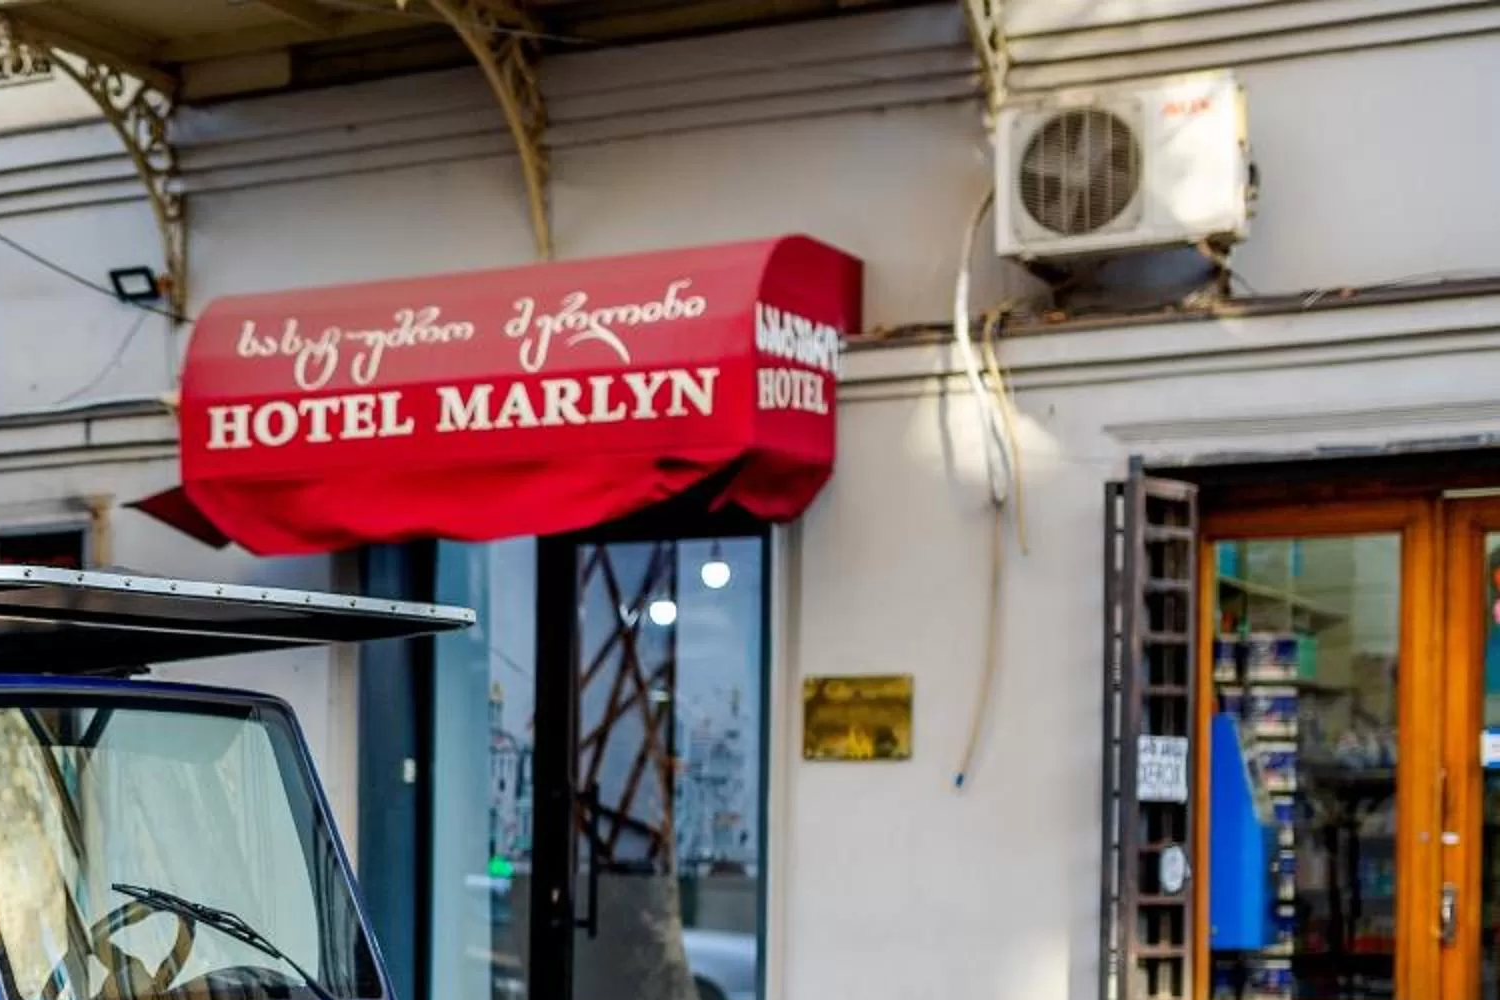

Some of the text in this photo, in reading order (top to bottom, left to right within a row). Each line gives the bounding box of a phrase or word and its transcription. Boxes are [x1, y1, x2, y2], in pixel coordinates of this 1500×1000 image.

[207, 367, 719, 450] HOTEL MARLYN
[757, 367, 828, 415] HOTEL
